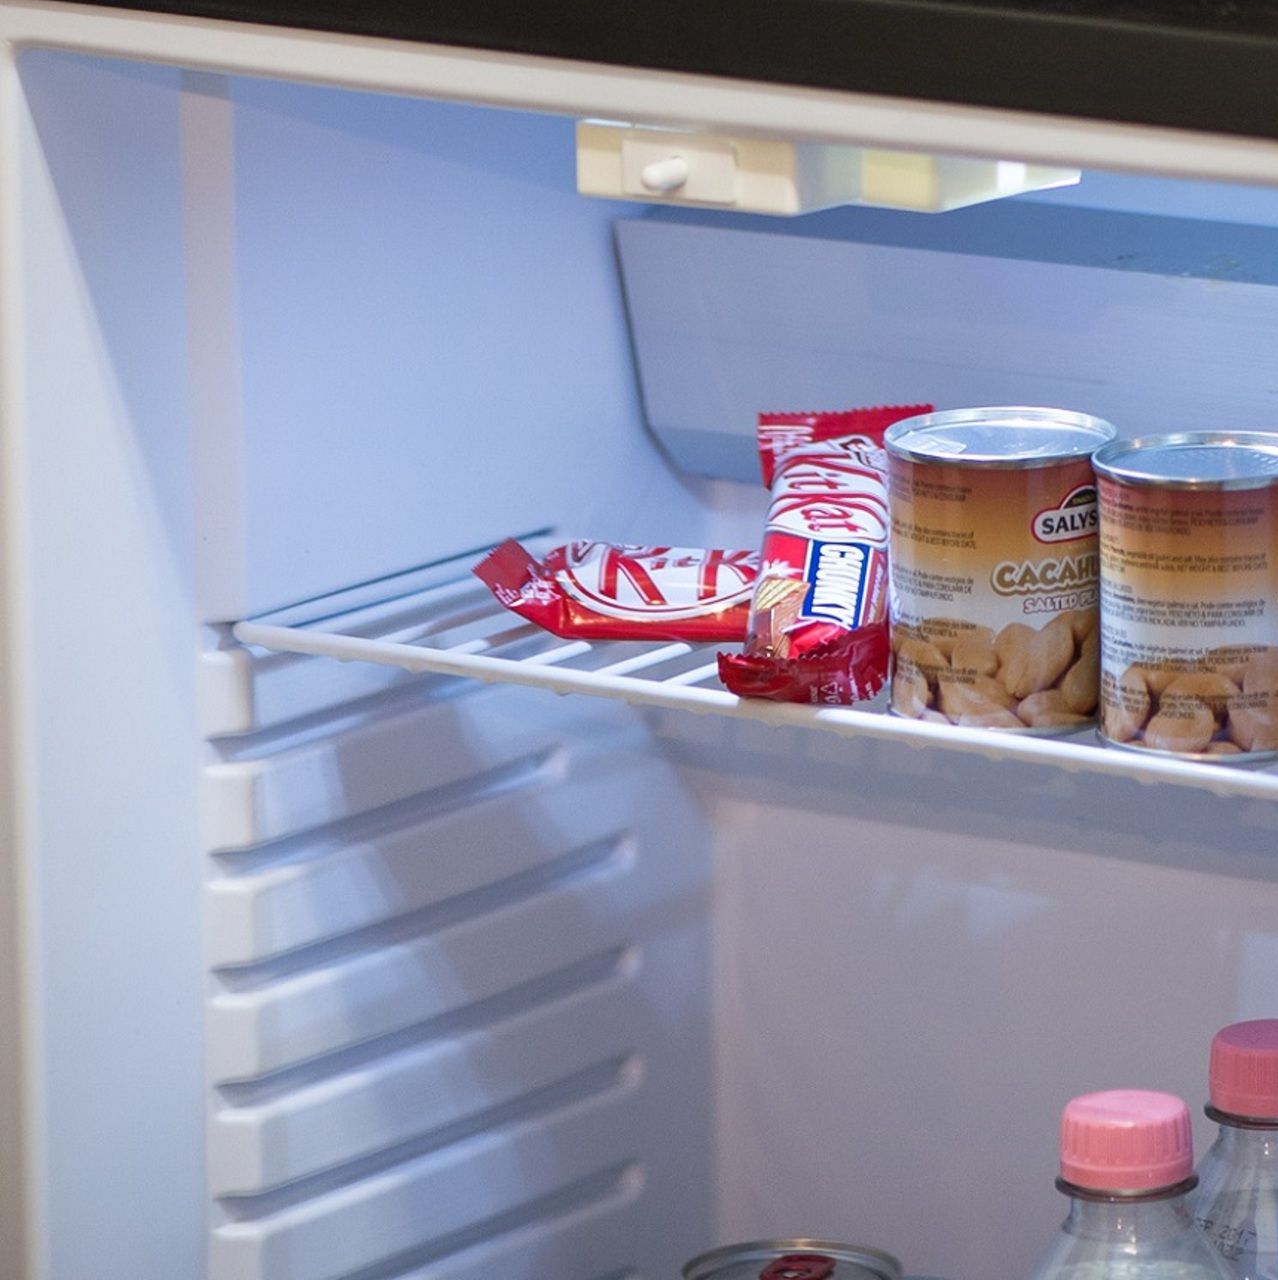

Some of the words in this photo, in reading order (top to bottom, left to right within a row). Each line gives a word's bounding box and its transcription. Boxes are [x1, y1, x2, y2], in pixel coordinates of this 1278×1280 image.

[598, 546, 758, 607] KitK
[811, 543, 865, 628] CHUNKY
[1024, 594, 1078, 613] SALTED
